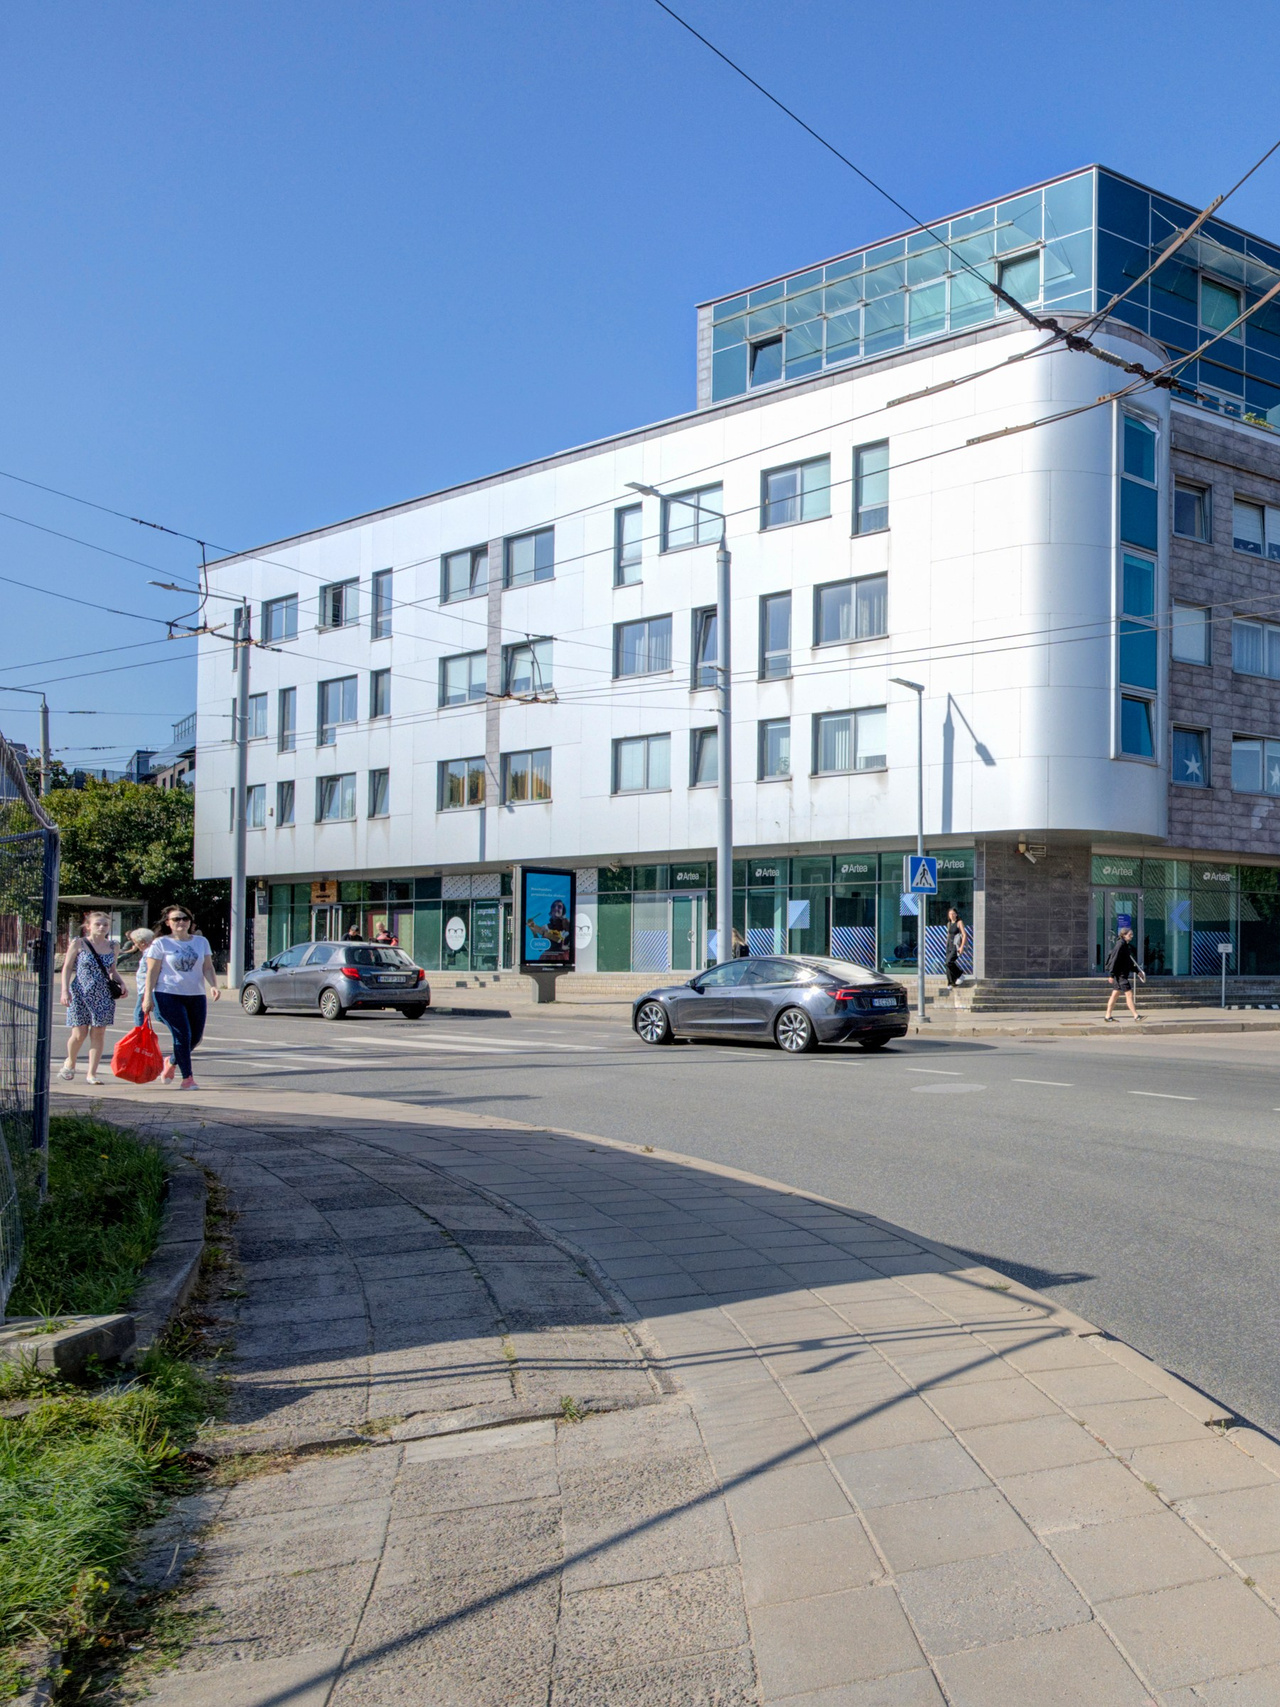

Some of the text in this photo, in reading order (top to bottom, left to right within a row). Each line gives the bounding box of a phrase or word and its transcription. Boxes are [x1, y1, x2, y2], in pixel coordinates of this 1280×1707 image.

[849, 864, 868, 873] Artea
[943, 859, 965, 869] Artea
[683, 872, 700, 880] Artea
[762, 868, 780, 877] Artea
[1112, 867, 1133, 876] Artea
[1210, 872, 1231, 881] Artea
